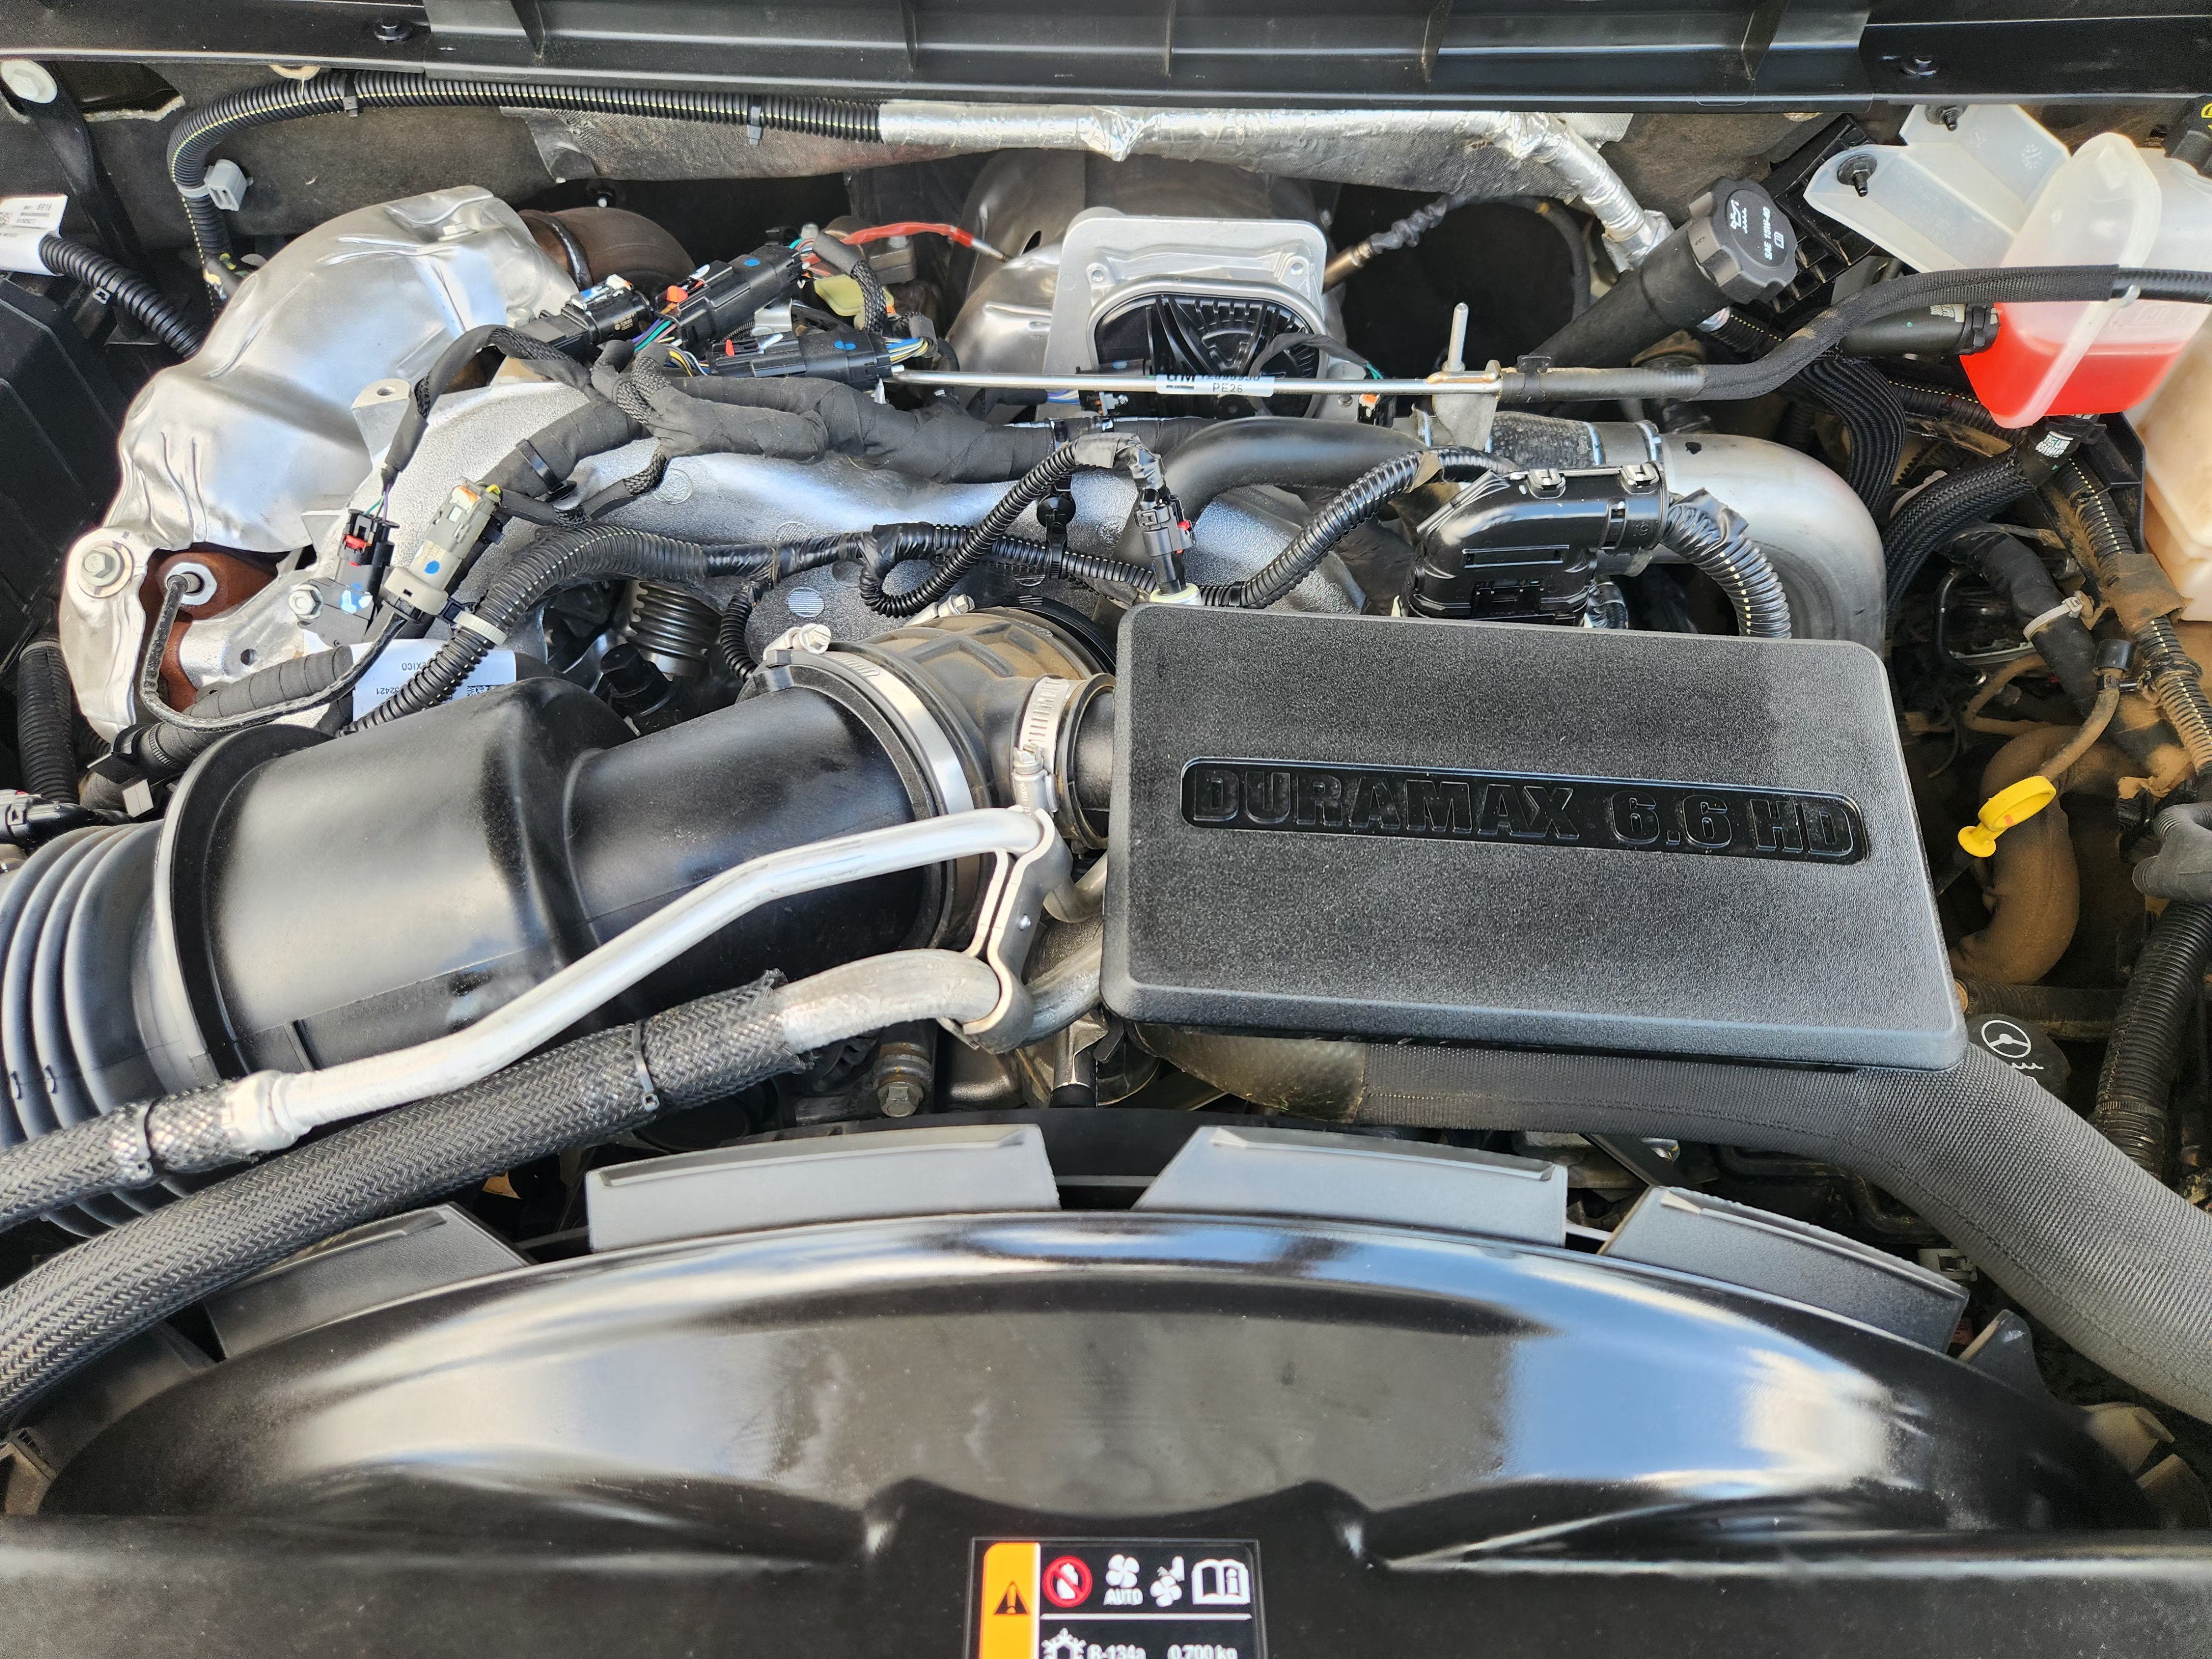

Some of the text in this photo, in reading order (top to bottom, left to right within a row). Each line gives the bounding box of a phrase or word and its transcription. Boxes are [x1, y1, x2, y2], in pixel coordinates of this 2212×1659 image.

[1762, 206, 1772, 260] SAE 15W-40
[1213, 382, 1243, 393] PE26
[401, 662, 426, 671] XICO
[1192, 769, 1854, 857] DURAMAX 6.6 HD
[1104, 1588, 1144, 1605] AUTO
